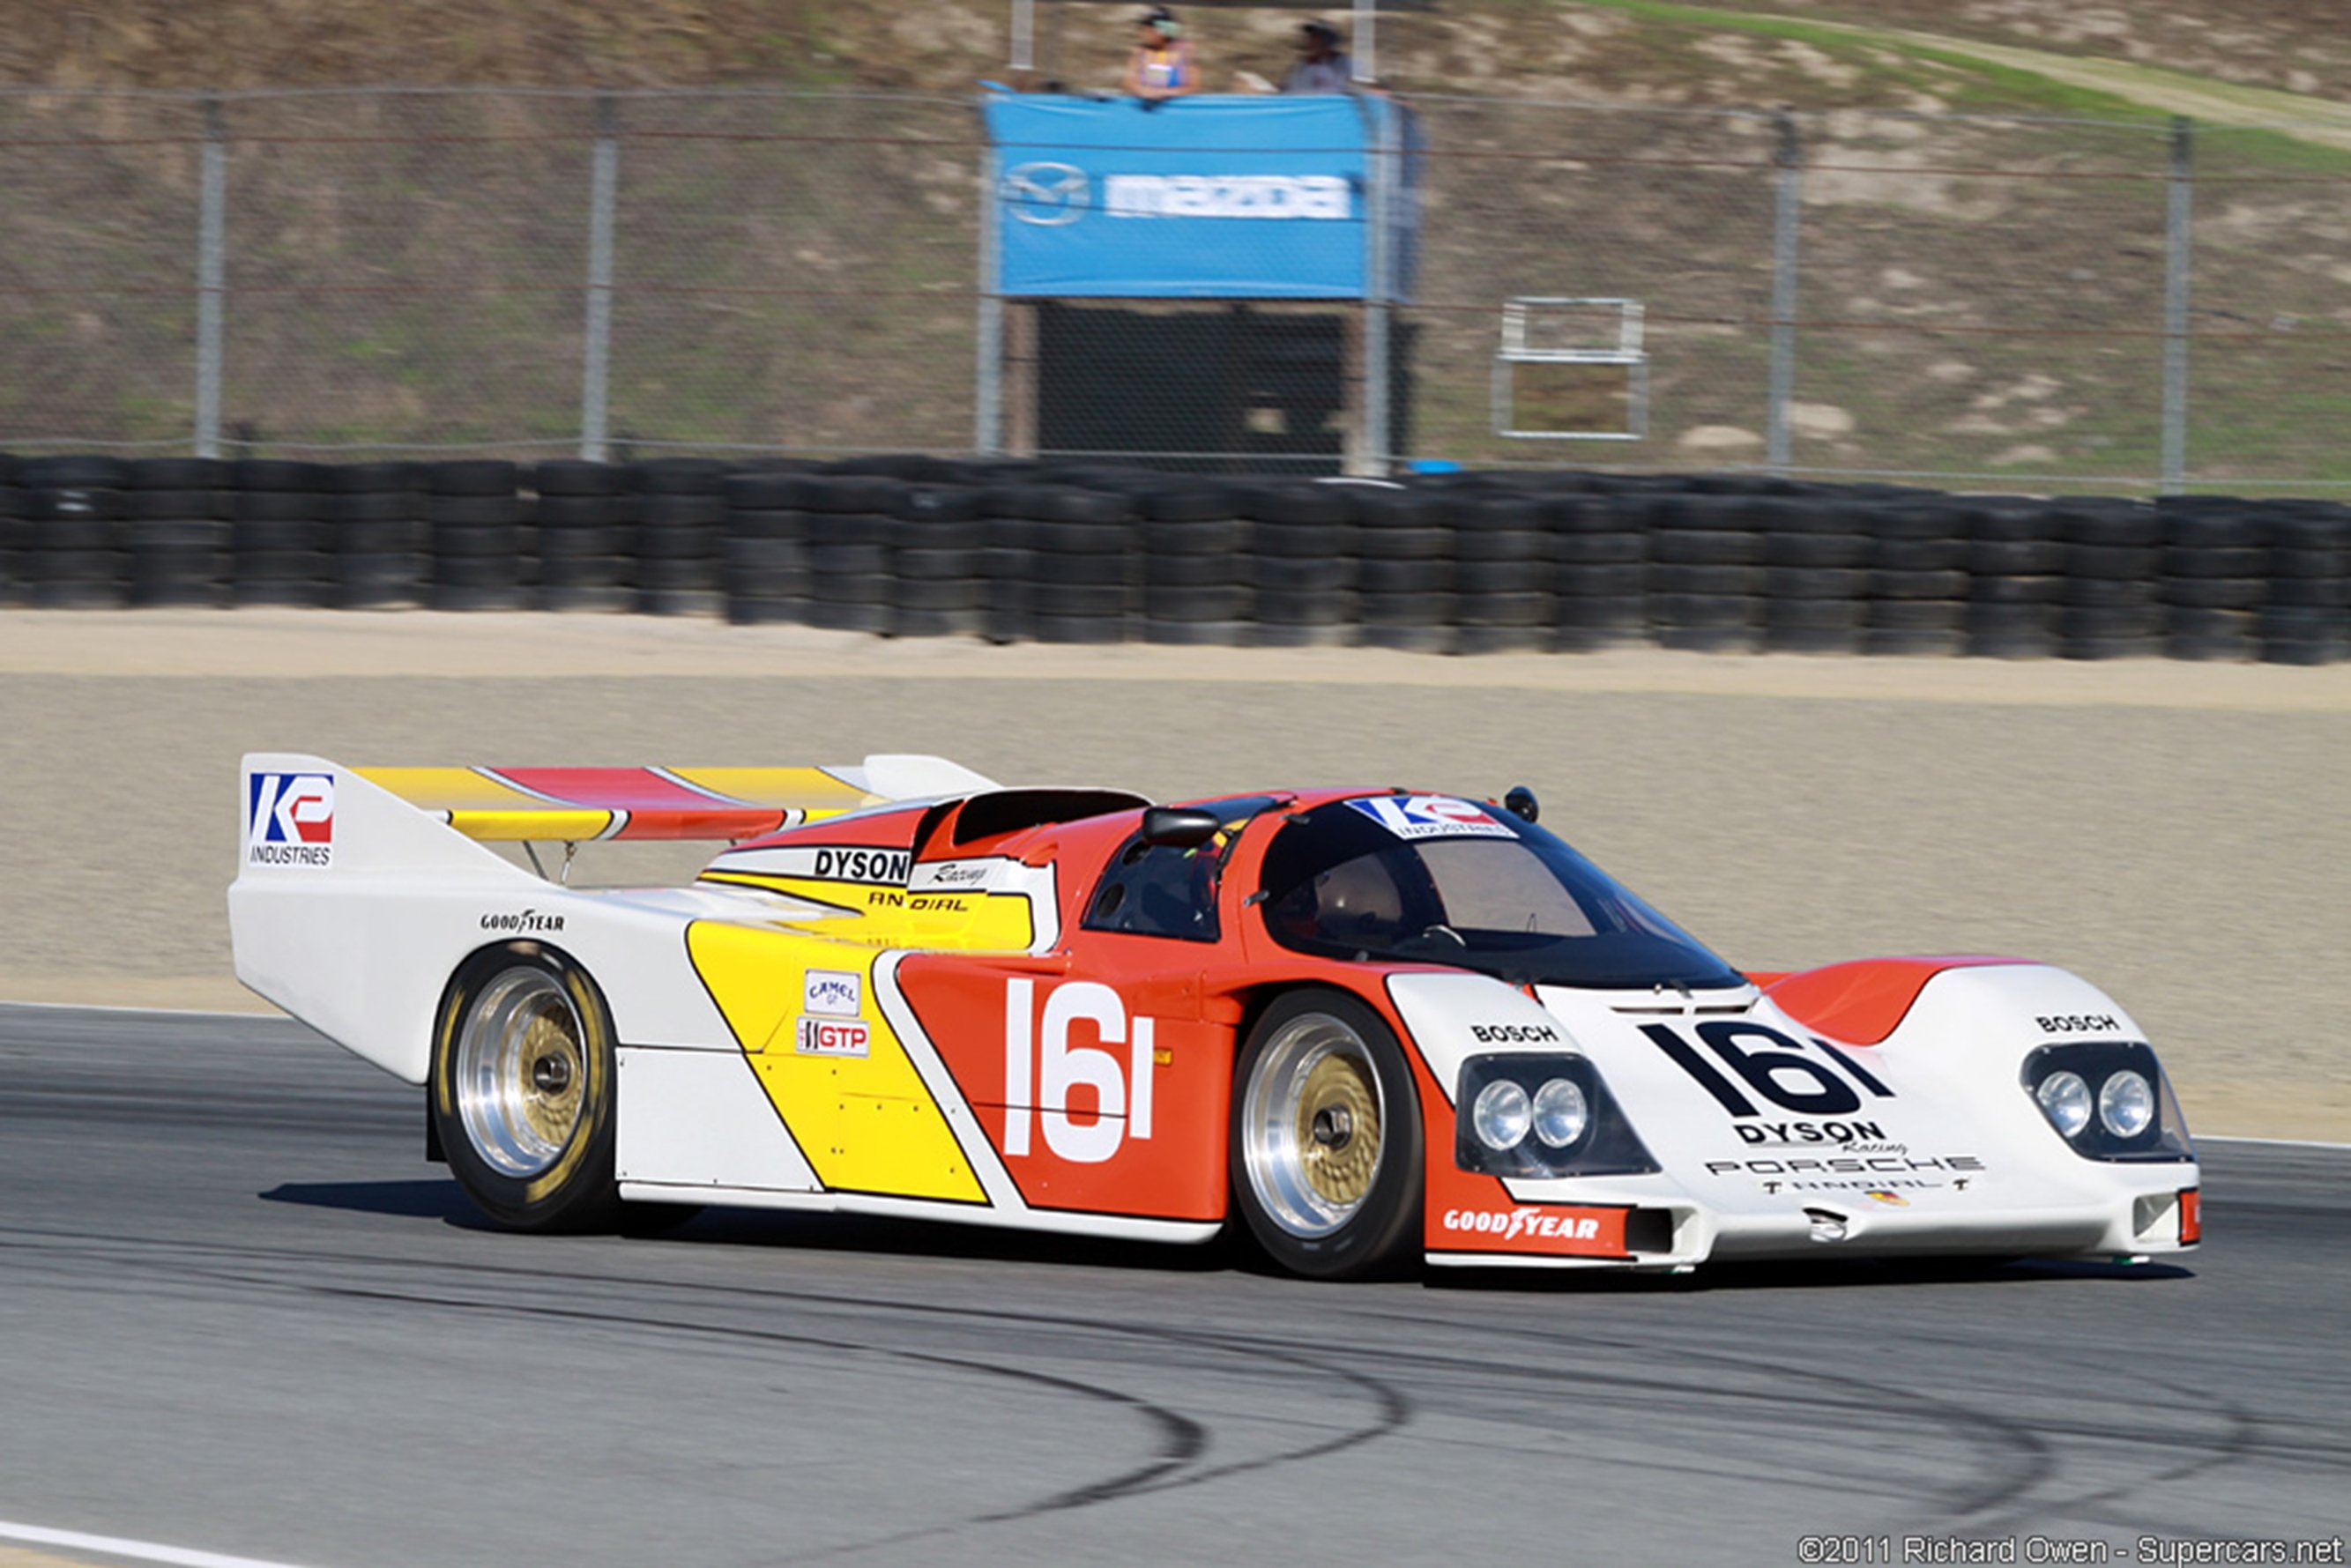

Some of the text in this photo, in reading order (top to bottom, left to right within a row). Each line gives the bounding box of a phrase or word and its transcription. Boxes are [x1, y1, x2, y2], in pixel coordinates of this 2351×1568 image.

[250, 845, 331, 866] INDUSTRIES
[815, 849, 909, 881] DYSON
[480, 909, 565, 933] GOODYEAR
[809, 981, 856, 1002] CAMEL
[1470, 1025, 1560, 1043] BOSCH
[2035, 1014, 2121, 1033] BOSCH
[819, 1026, 867, 1048] GTP
[1004, 977, 1154, 1163] 161
[1637, 1021, 1896, 1118] 161
[1733, 1121, 1887, 1145] DYSON
[1705, 1156, 1986, 1176] PORSCHE
[1443, 1207, 1599, 1240] GOODYEAR
